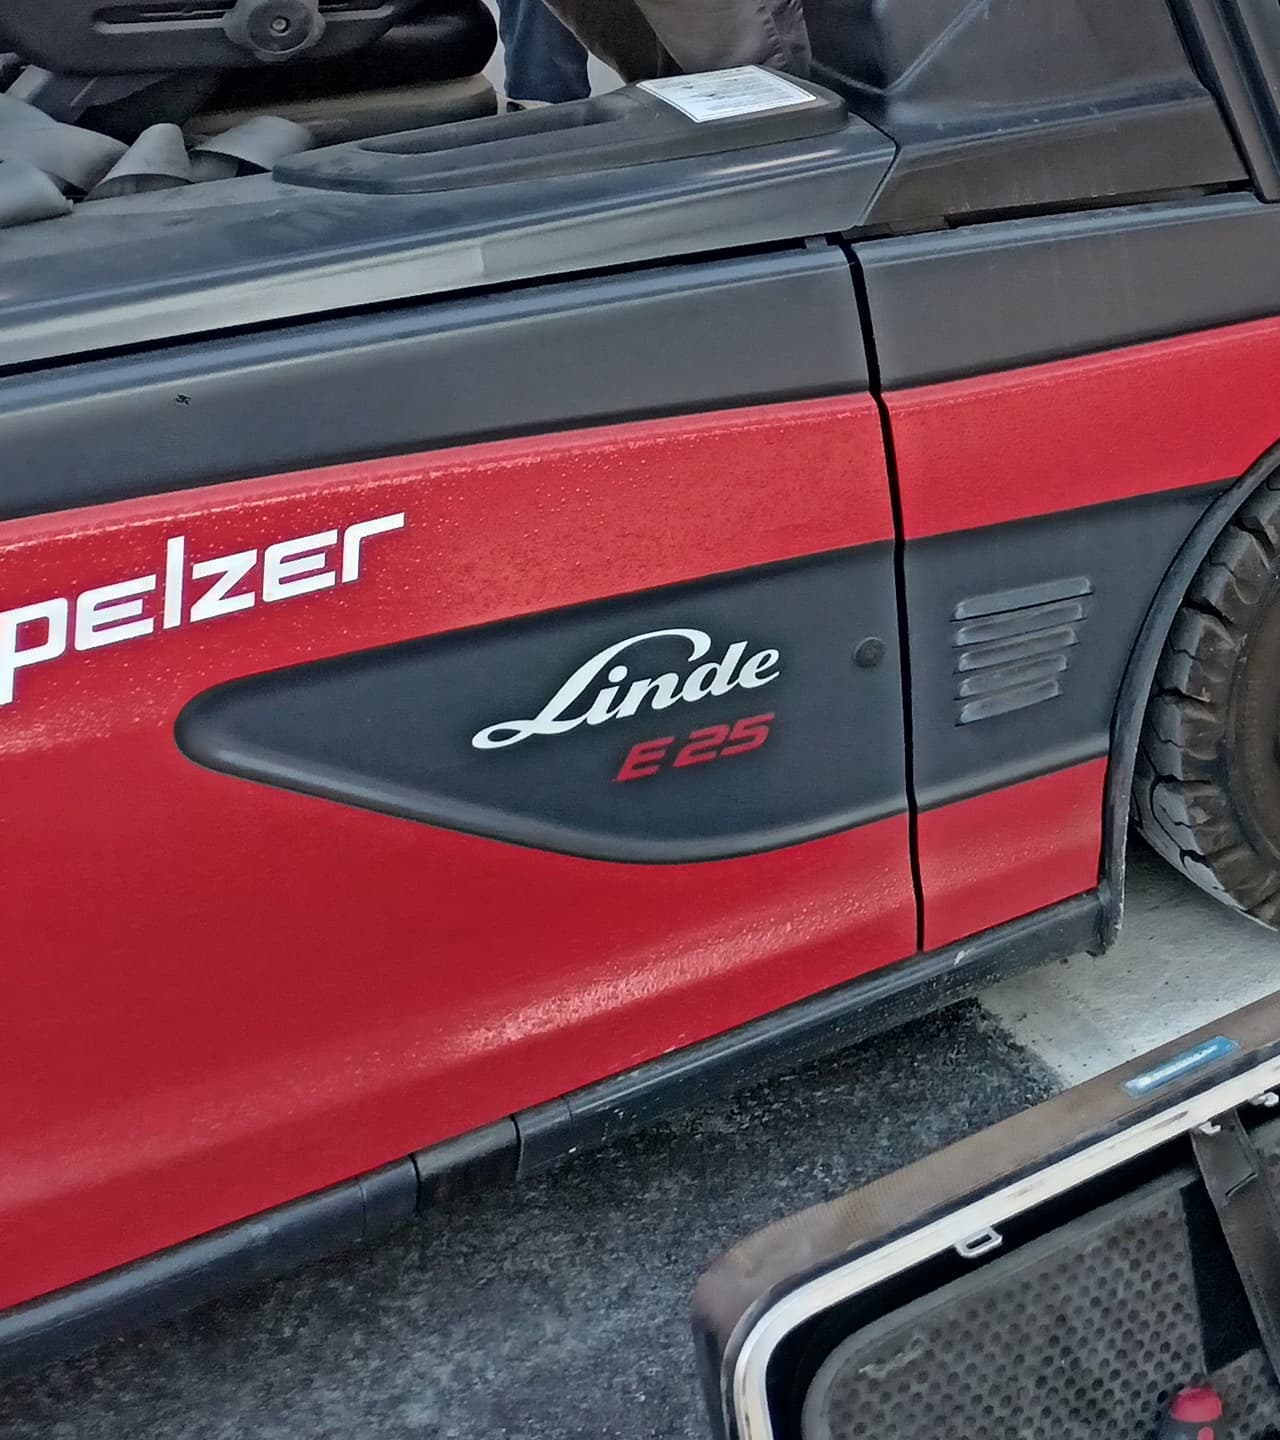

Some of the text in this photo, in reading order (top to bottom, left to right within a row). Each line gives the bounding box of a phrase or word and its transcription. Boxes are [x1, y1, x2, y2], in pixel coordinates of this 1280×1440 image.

[472, 628, 780, 749] Linde
[616, 713, 775, 783] E 25
